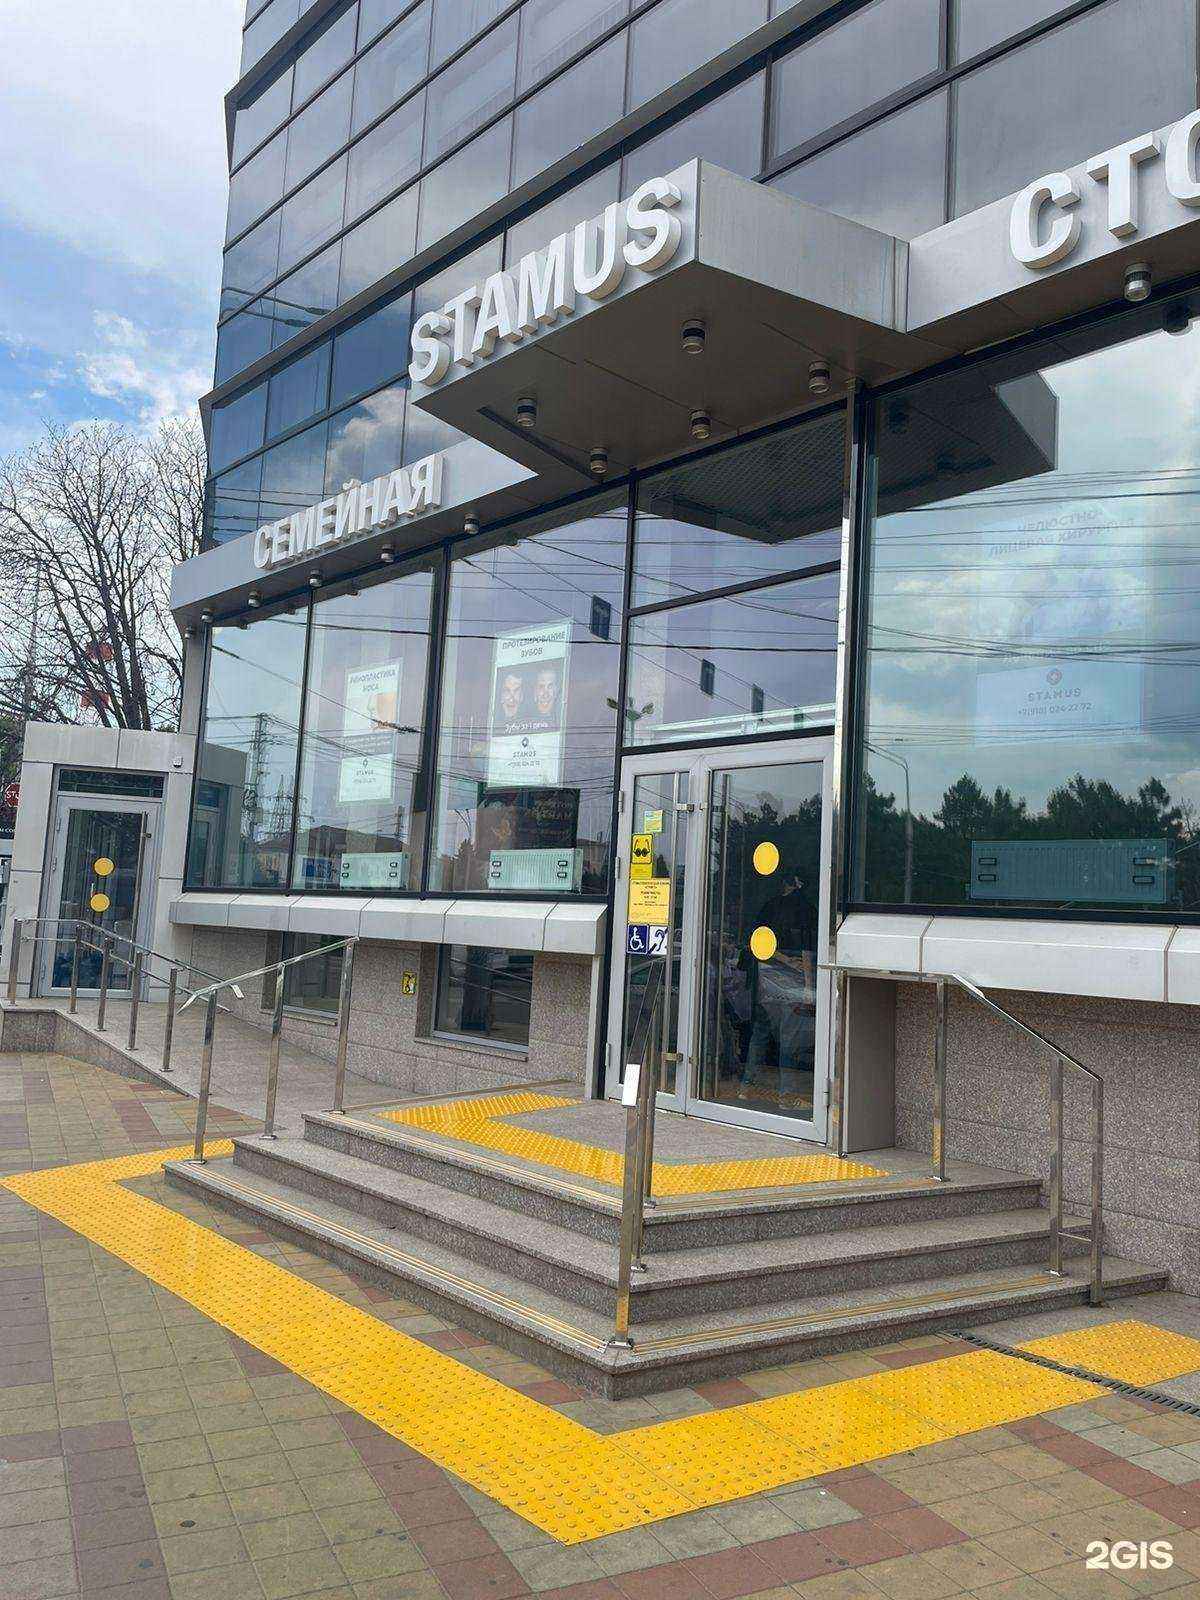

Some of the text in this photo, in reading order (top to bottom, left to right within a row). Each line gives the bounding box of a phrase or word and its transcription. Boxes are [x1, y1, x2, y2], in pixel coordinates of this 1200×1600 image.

[408, 177, 682, 386] STAMUS
[253, 453, 446, 569] СЕМЕЙНАЯ
[1028, 687, 1081, 702] STAMUS
